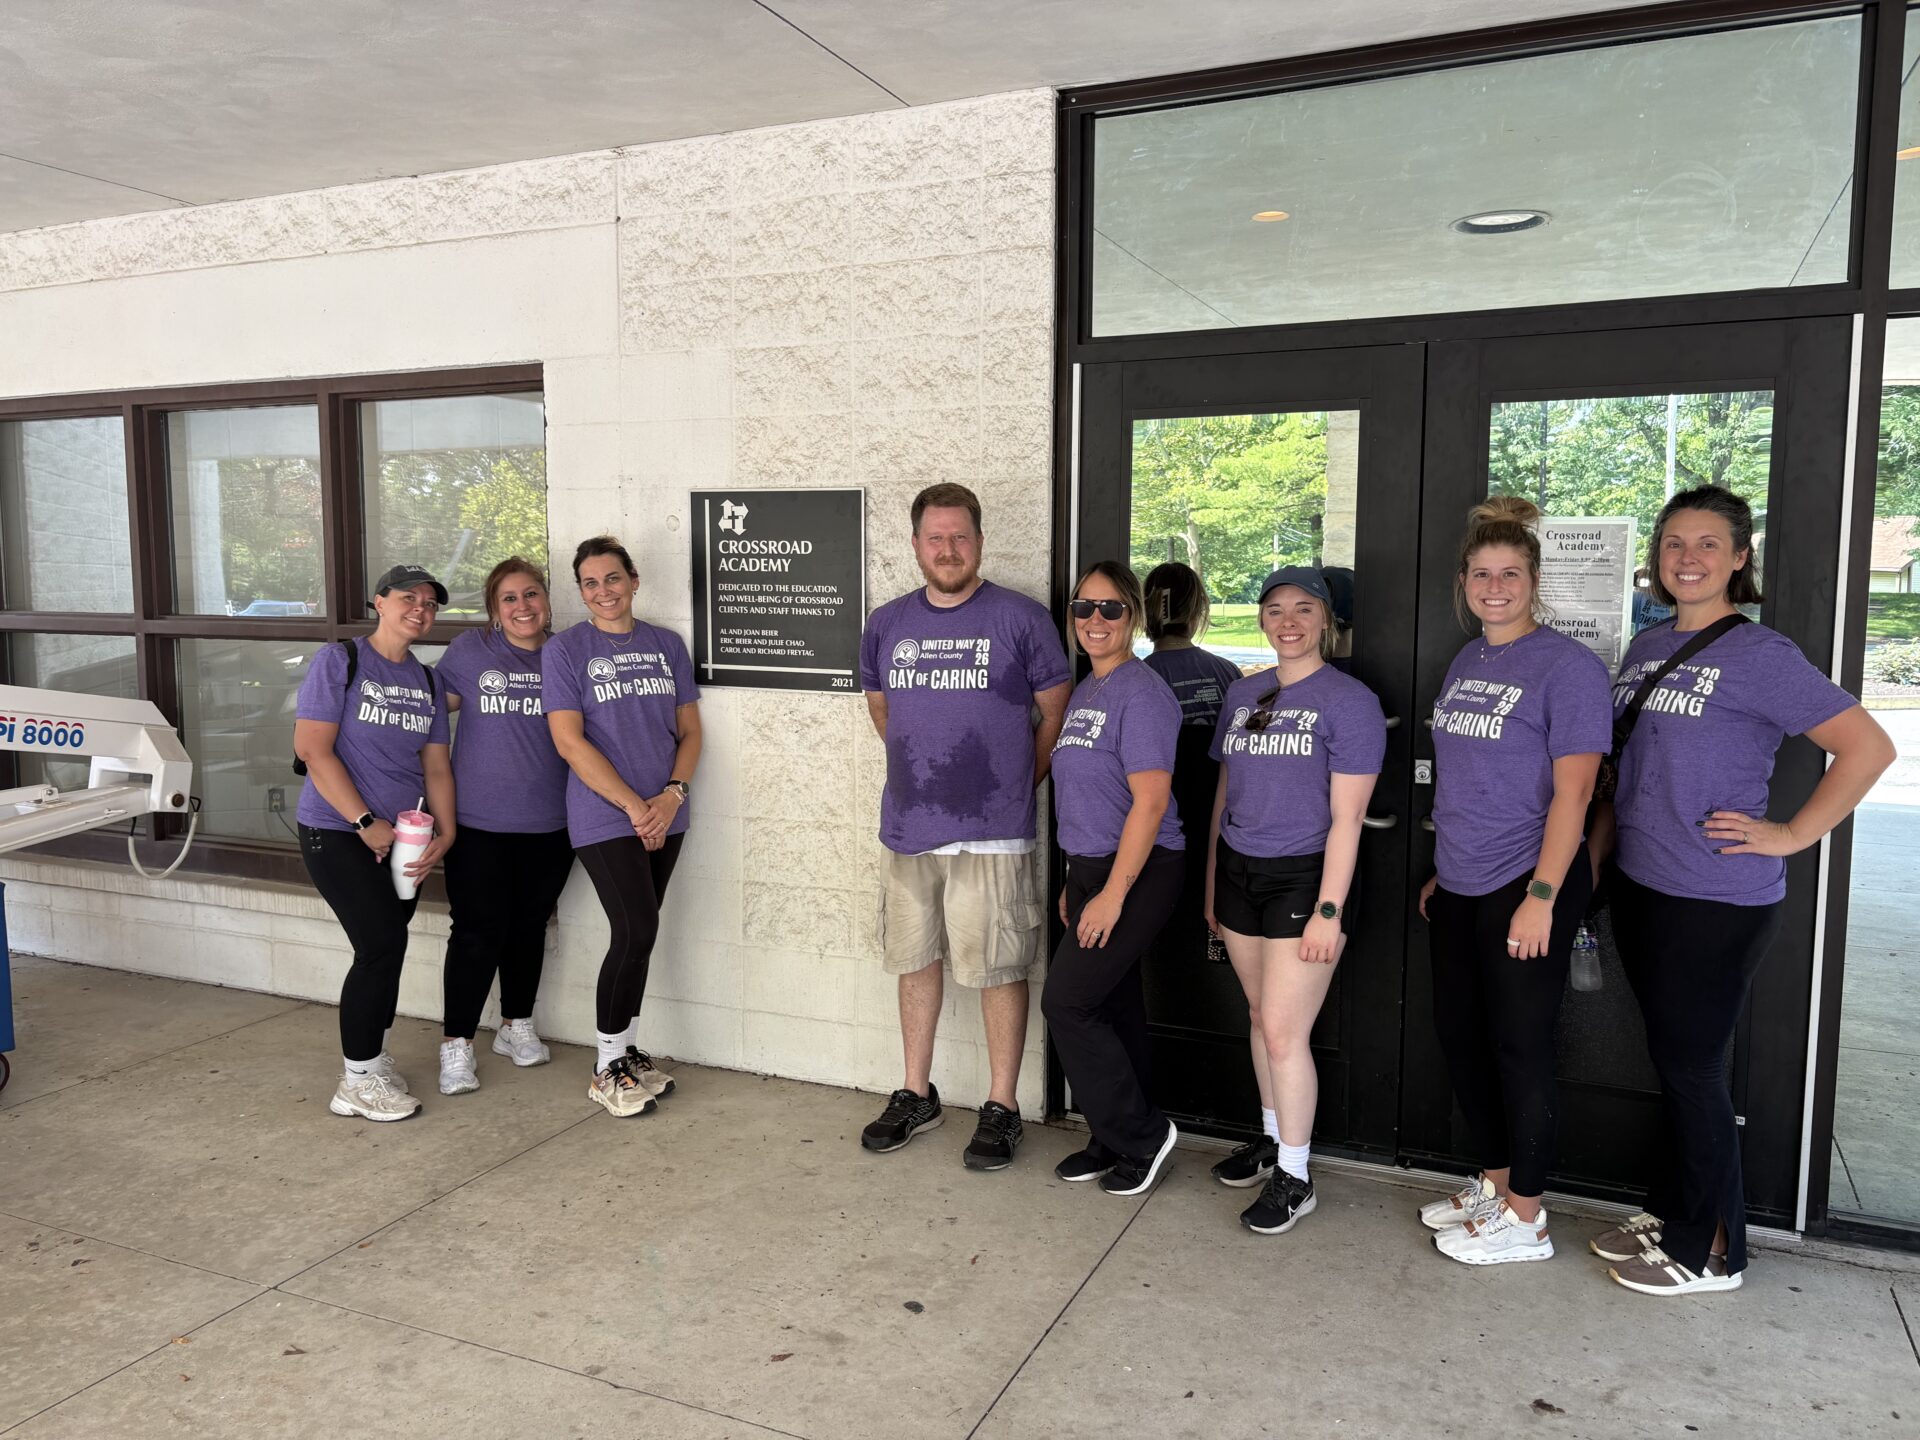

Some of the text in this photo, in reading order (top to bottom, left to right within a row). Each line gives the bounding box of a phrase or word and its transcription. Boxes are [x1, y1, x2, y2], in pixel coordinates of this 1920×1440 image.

[1546, 529, 1601, 540] Crossroad
[719, 540, 813, 555] CROSSROAD
[1557, 541, 1605, 553] Academy
[719, 558, 792, 572] ACADEMY
[719, 584, 838, 593] DEDICATED TO THE EDUCATION
[736, 595, 781, 604] WELL-BEING
[783, 596, 794, 604] OF
[795, 596, 843, 605] CROSSROAD
[719, 606, 748, 614] CLIENTS
[768, 607, 789, 615] STAFF
[791, 608, 822, 616] THANKS
[824, 608, 835, 616] TO
[1542, 617, 1597, 627] Crossroad
[922, 639, 975, 650] UNITED WAY
[976, 638, 990, 652] 20
[613, 653, 658, 664] UNITED WAY
[939, 652, 963, 660] County
[975, 652, 989, 665] 26
[508, 672, 541, 682] UNITED
[889, 669, 988, 689] DAY OF CARING
[1701, 667, 1721, 680] 20
[831, 678, 853, 687] 2021
[1460, 679, 1506, 695] UNITED WAY
[1693, 677, 1714, 695] 26
[594, 681, 622, 703] DAY
[622, 682, 633, 694] OF
[1501, 686, 1522, 703] 20
[480, 695, 508, 713] DAY
[508, 699, 520, 711] OF
[1467, 694, 1488, 704] County
[1641, 687, 1705, 717] ARING
[358, 702, 389, 725] DAY
[389, 712, 400, 725] OF
[1279, 709, 1301, 719] WAY
[1300, 711, 1318, 724] 20
[1447, 711, 1503, 739] CARING
[22, 718, 84, 748] 8000
[1222, 734, 1313, 756] AY OF CARING
